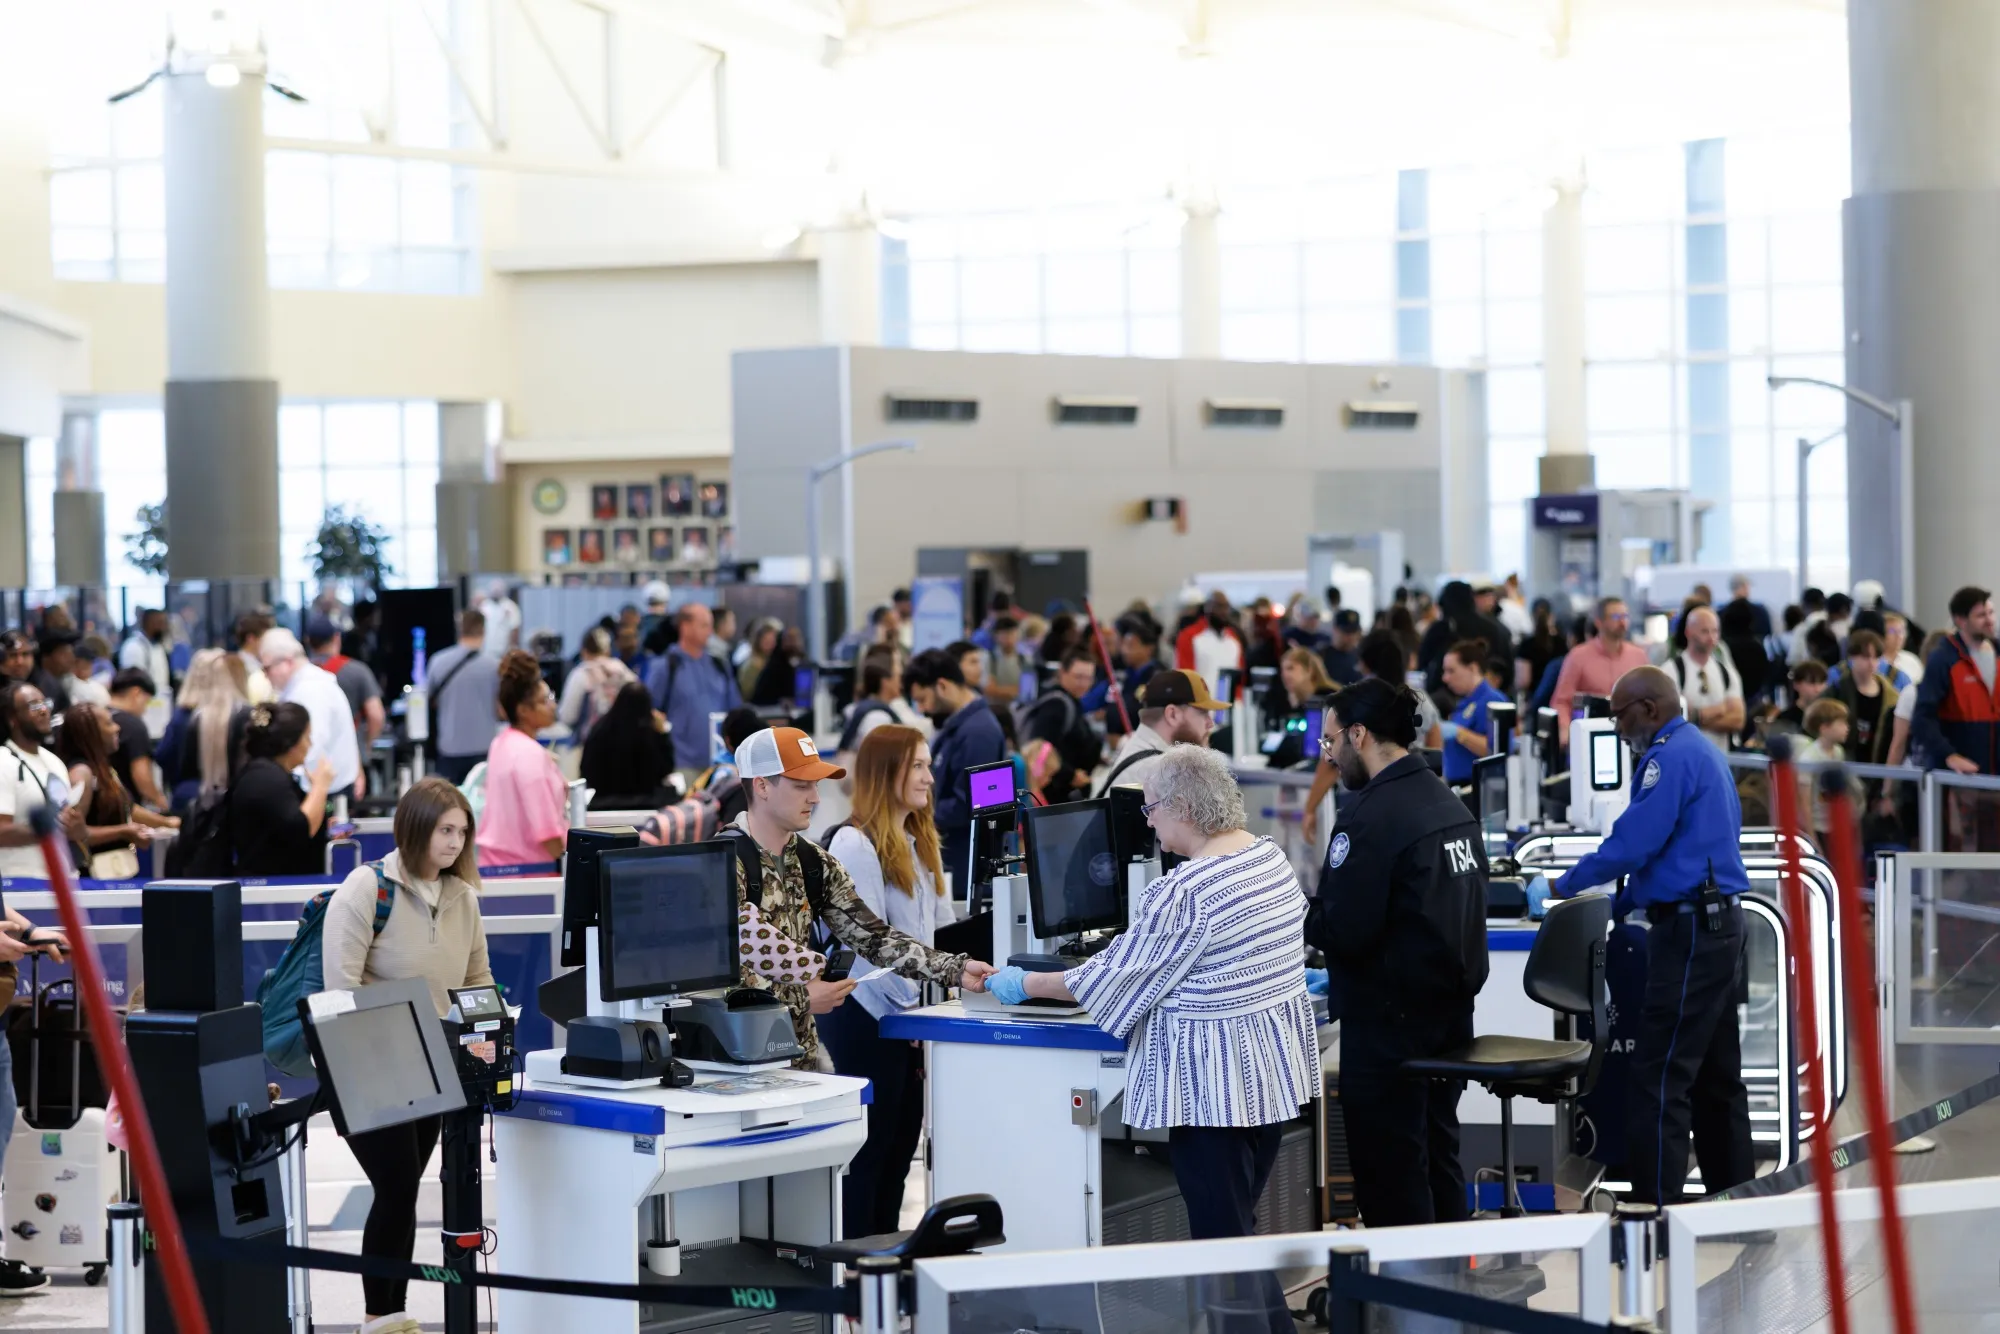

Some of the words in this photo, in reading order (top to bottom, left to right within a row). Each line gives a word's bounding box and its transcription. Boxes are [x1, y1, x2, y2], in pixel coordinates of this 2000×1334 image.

[1443, 838, 1478, 873] TSA
[1002, 1033, 1022, 1041] IDEMIA
[776, 1041, 794, 1050] IDEMIA
[634, 1140, 655, 1150] GCX
[420, 1265, 462, 1284] HOU
[731, 1287, 777, 1309] HOU
